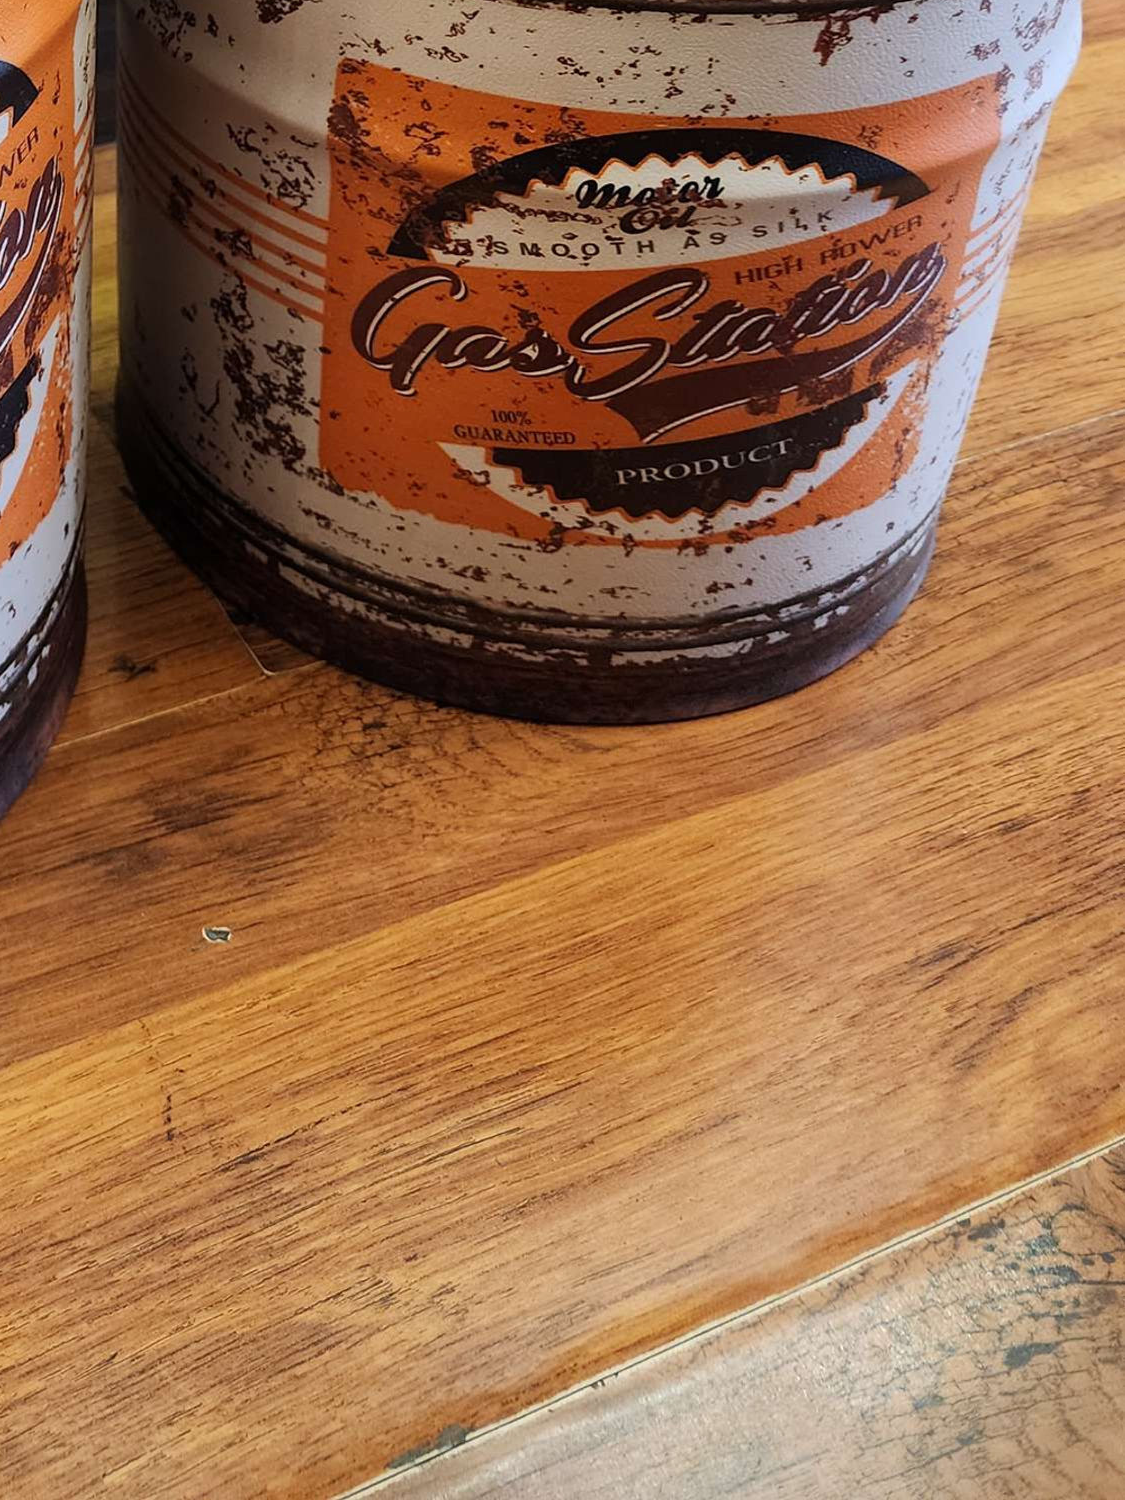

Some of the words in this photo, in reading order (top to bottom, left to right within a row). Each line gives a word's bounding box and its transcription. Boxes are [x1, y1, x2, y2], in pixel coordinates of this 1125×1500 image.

[493, 238, 656, 258] SMOOTH
[683, 231, 726, 249] AS
[753, 209, 834, 238] SILK
[619, 205, 698, 235] Oil
[734, 257, 805, 286] HIGH
[820, 214, 924, 266] POWER
[351, 267, 573, 396] Gas
[567, 241, 946, 400] Station
[453, 425, 576, 446] GUARANTEED
[492, 409, 532, 425] 100%
[615, 438, 794, 486] PRODUCT
